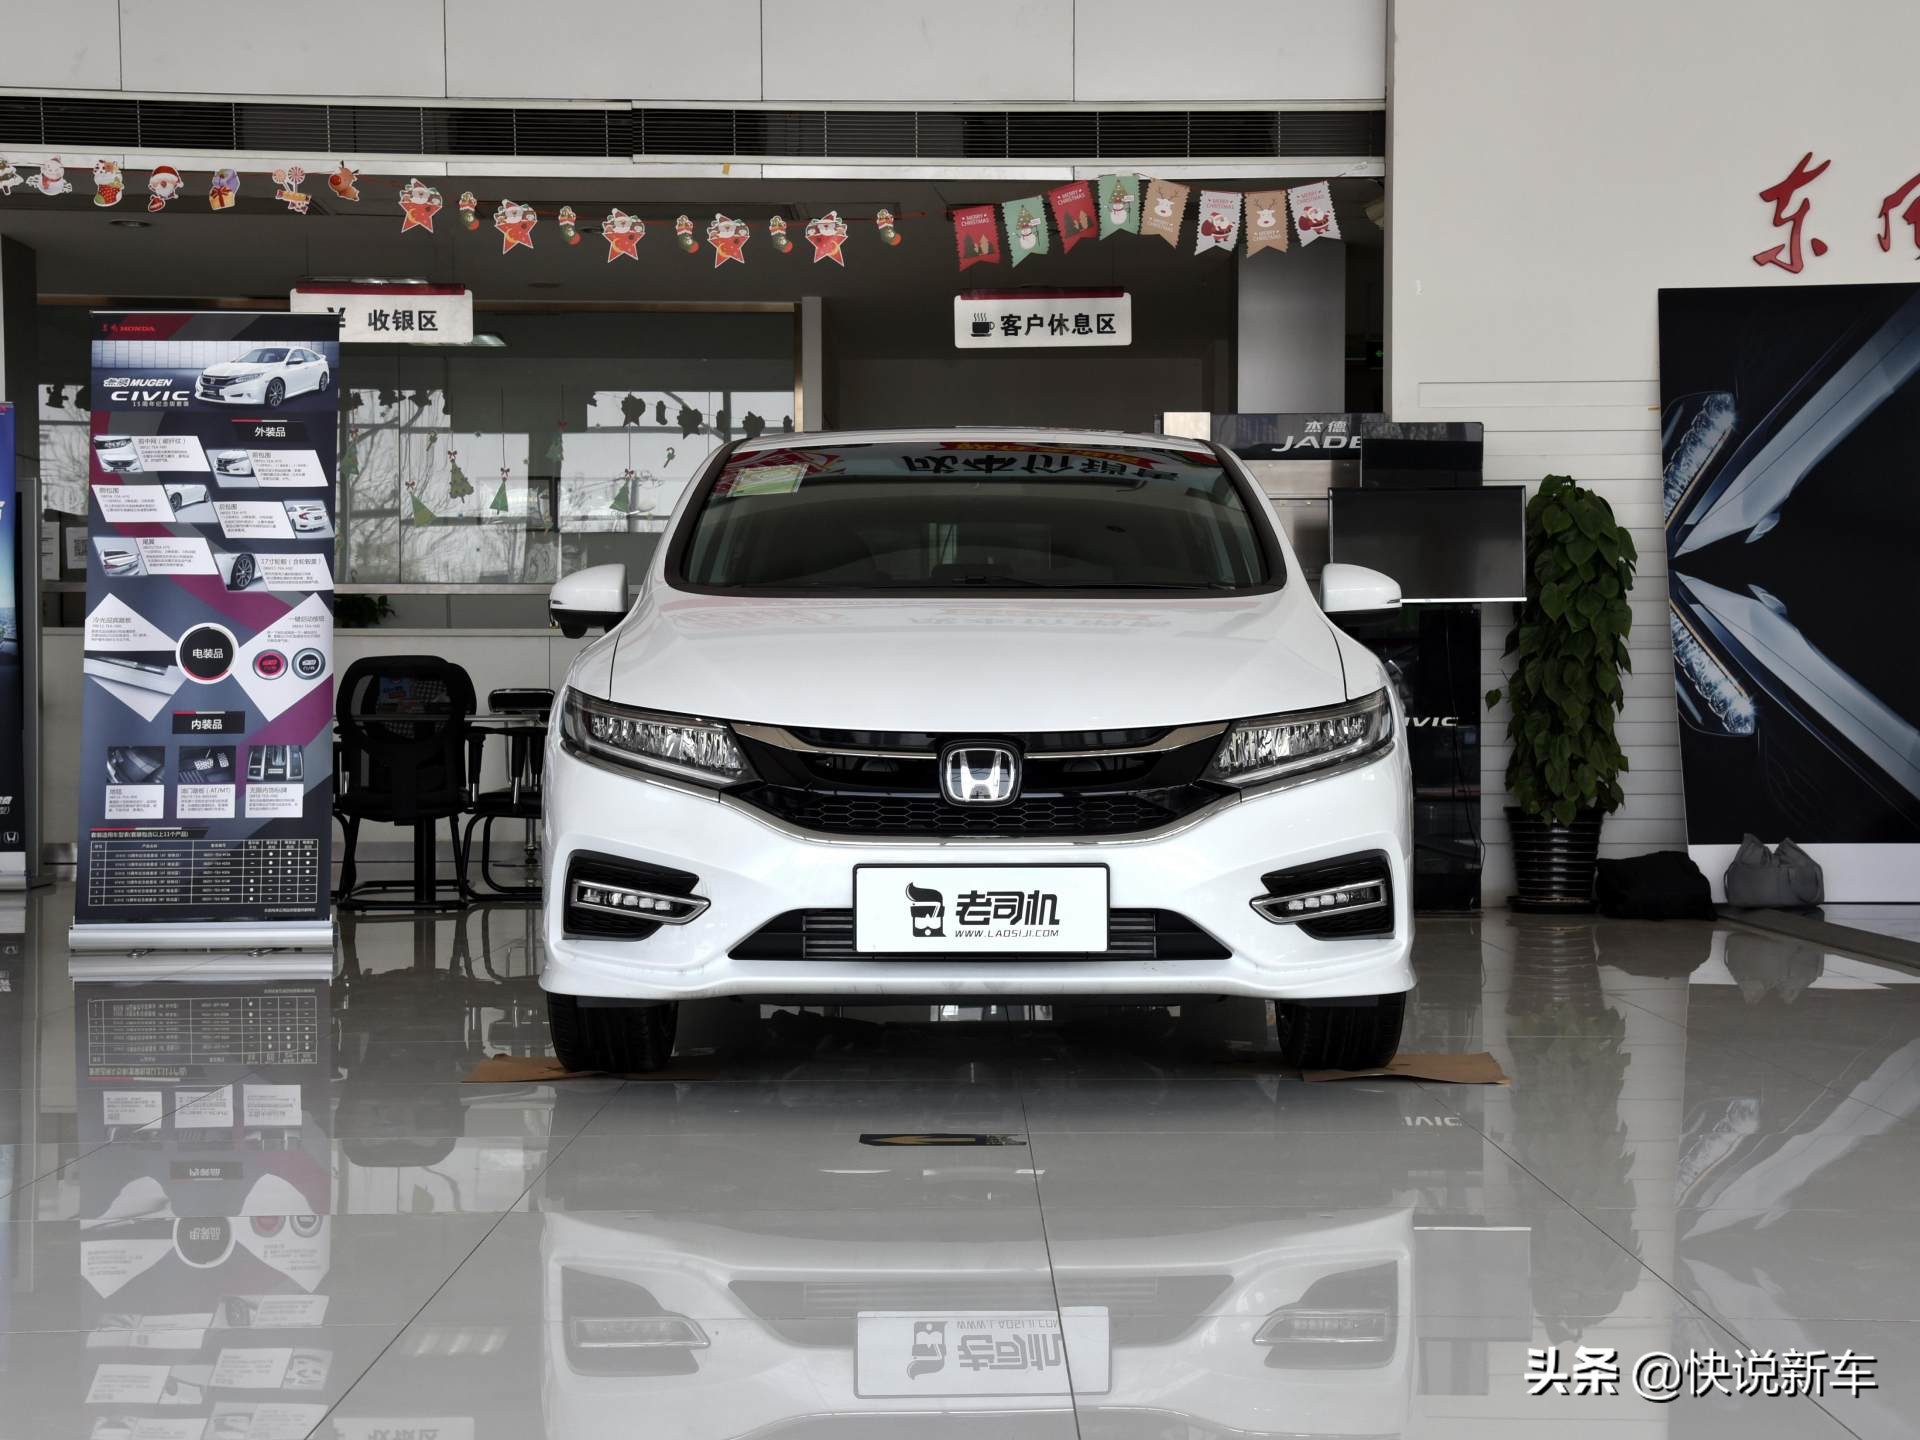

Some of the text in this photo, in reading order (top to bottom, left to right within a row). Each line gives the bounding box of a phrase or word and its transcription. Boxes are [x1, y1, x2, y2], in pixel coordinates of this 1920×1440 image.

[368, 309, 438, 331] 收银区
[1000, 312, 1117, 337] 客户休息区
[129, 378, 173, 387] MUGEN
[110, 390, 191, 401] CIVIC
[254, 426, 286, 438] 外装品
[1304, 420, 1347, 433] 杰德
[192, 648, 224, 659] 电装品
[191, 719, 223, 730] 内装品
[1404, 716, 1459, 727] IVIC
[955, 890, 1060, 926] 老司机
[954, 929, 1060, 938] WWW.LAOSIJI.COM
